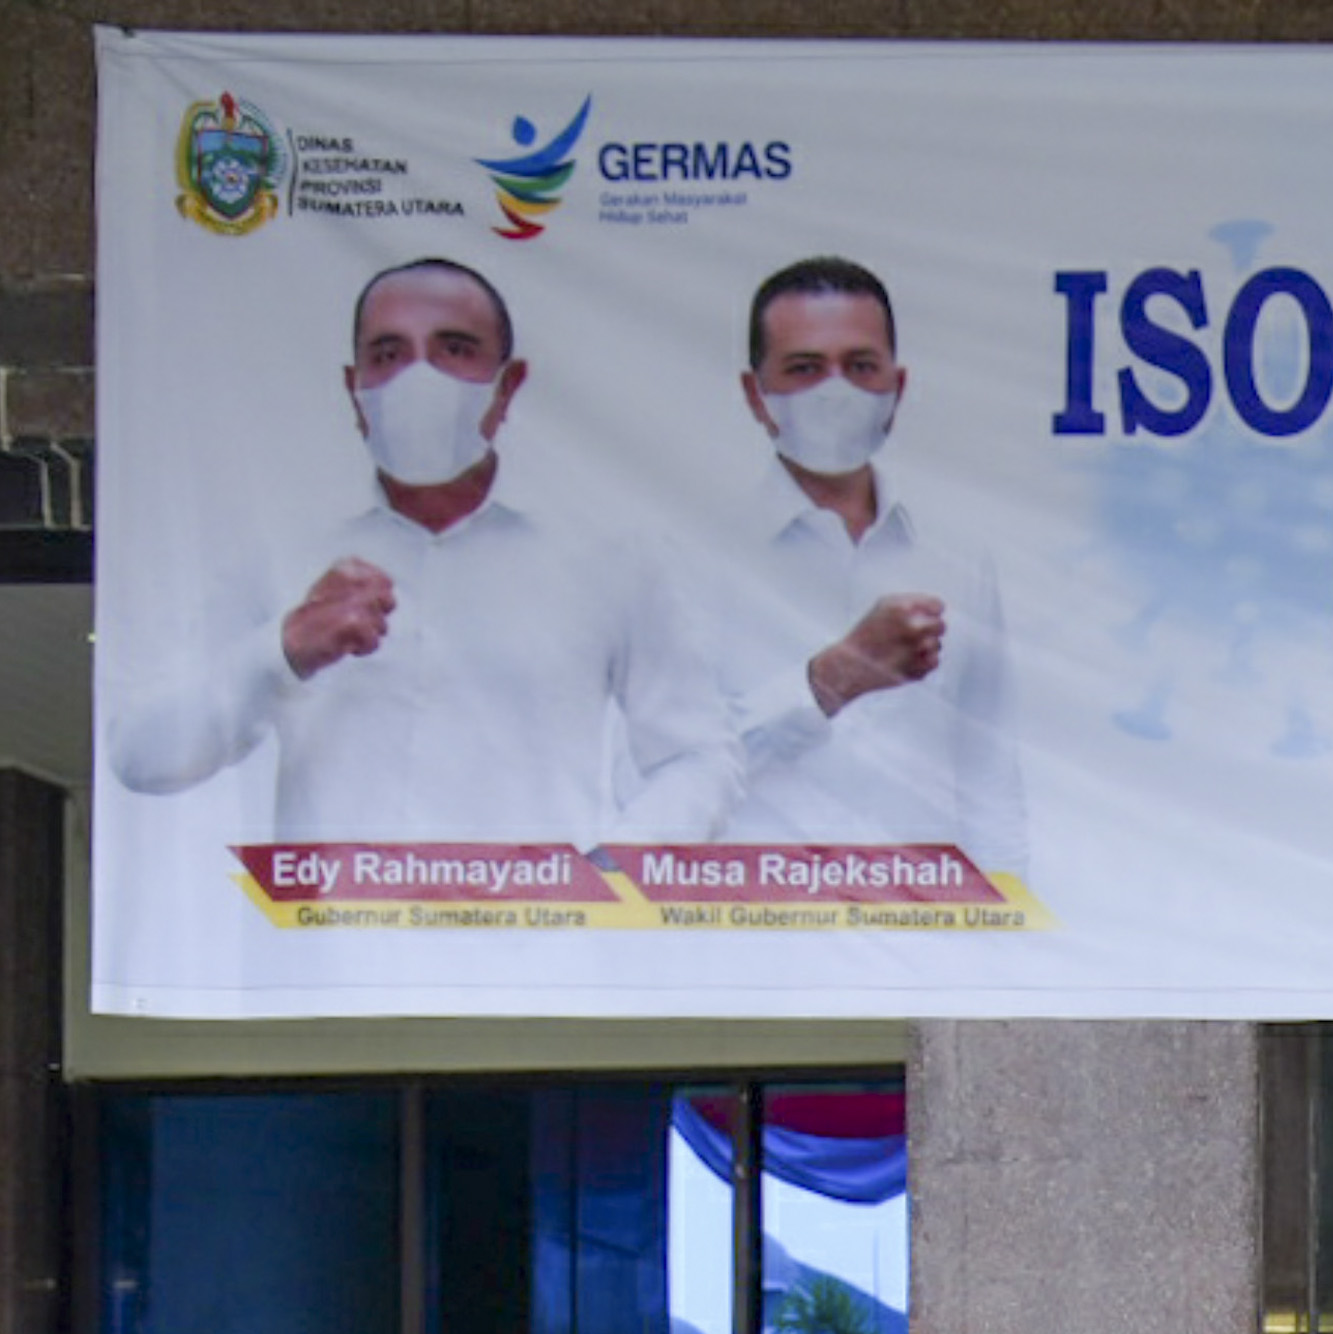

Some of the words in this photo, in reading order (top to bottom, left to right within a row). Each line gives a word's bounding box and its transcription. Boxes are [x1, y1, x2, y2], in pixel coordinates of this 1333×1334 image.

[297, 135, 354, 152] DINAS
[303, 157, 408, 174] KESEHATAN
[598, 141, 792, 182] GERMAS
[301, 178, 382, 196] PROVINSI
[298, 197, 398, 218] SUMATERA
[401, 199, 465, 216] UTARA
[600, 191, 658, 207] Gerakan
[663, 190, 748, 209] Masyarakat
[600, 210, 643, 226] Hidup
[647, 210, 689, 225] Sehat
[272, 853, 341, 892] Edy
[354, 853, 572, 892] Rahmayadi
[641, 853, 746, 886] Musa
[759, 853, 964, 894] Rajekshah
[299, 905, 401, 926] Gubernur
[409, 905, 518, 927] Sumatera
[525, 906, 587, 926] Utara
[659, 905, 722, 926] Wakil
[729, 905, 840, 927] Gubernur
[846, 906, 956, 927] Sumatera
[964, 906, 1026, 927] Utara
